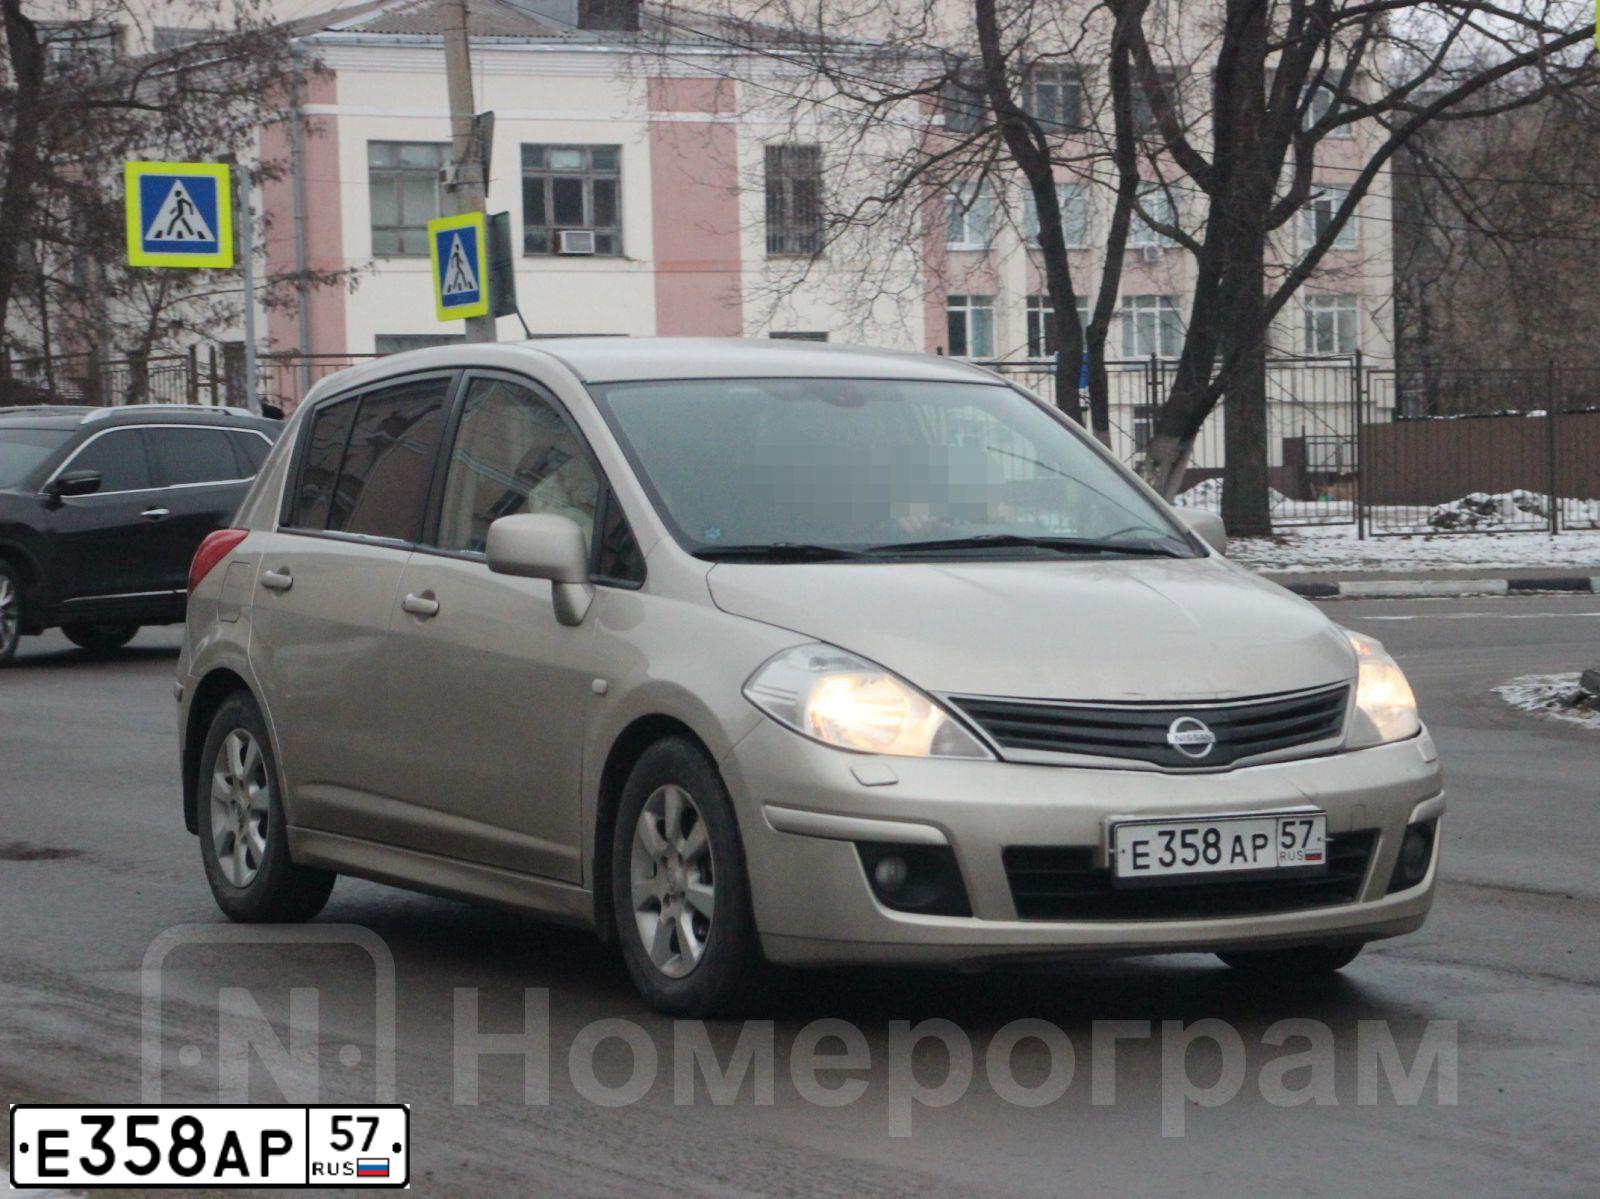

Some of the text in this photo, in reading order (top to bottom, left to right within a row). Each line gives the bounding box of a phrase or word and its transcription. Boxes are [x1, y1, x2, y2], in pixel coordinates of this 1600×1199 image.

[1174, 733, 1214, 742] NISSAN
[1281, 820, 1314, 849] 57
[1279, 850, 1304, 861] RUS
